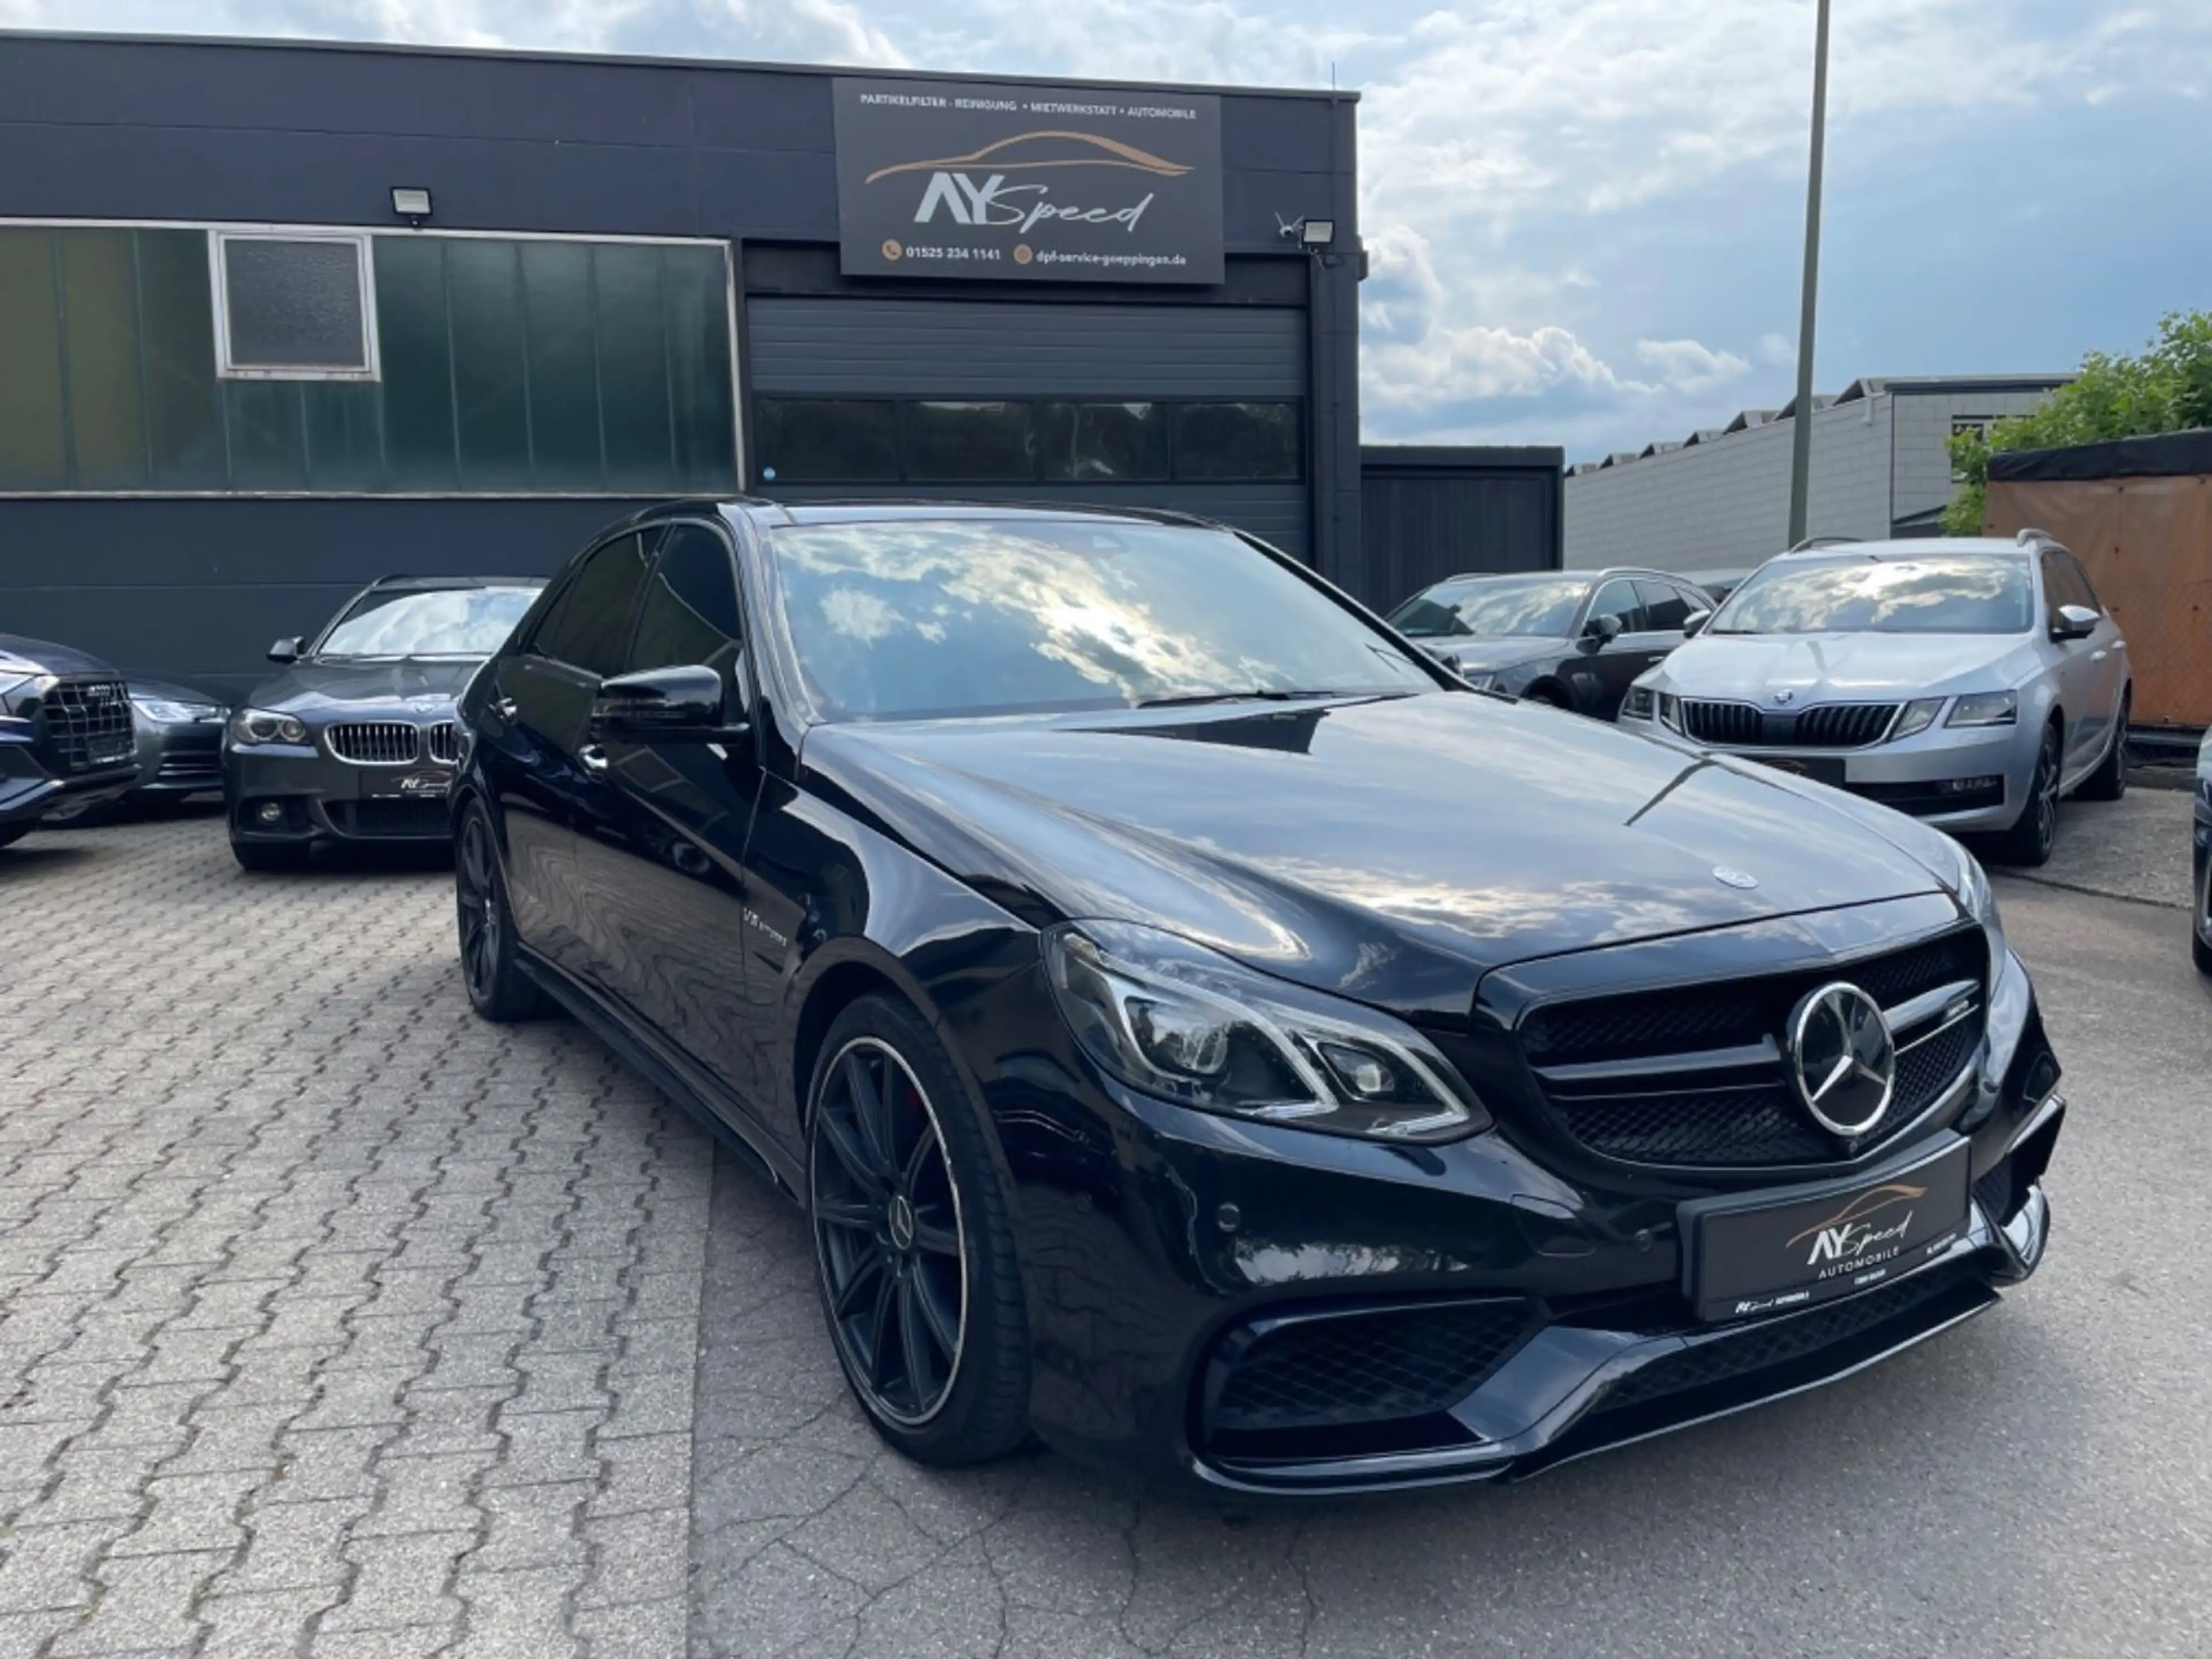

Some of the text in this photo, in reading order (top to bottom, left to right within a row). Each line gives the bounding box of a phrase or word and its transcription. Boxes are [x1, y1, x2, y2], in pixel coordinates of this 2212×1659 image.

[860, 93, 1196, 119] PARTIKELFILTER REINIGUNG MIETWERKSTATT AUTOMOBILE
[906, 245, 1001, 260] 01525 234 1141
[1036, 250, 1186, 267] dpf-service-goeppingen.de
[1819, 1246, 1899, 1279] AUTOMOBILE
